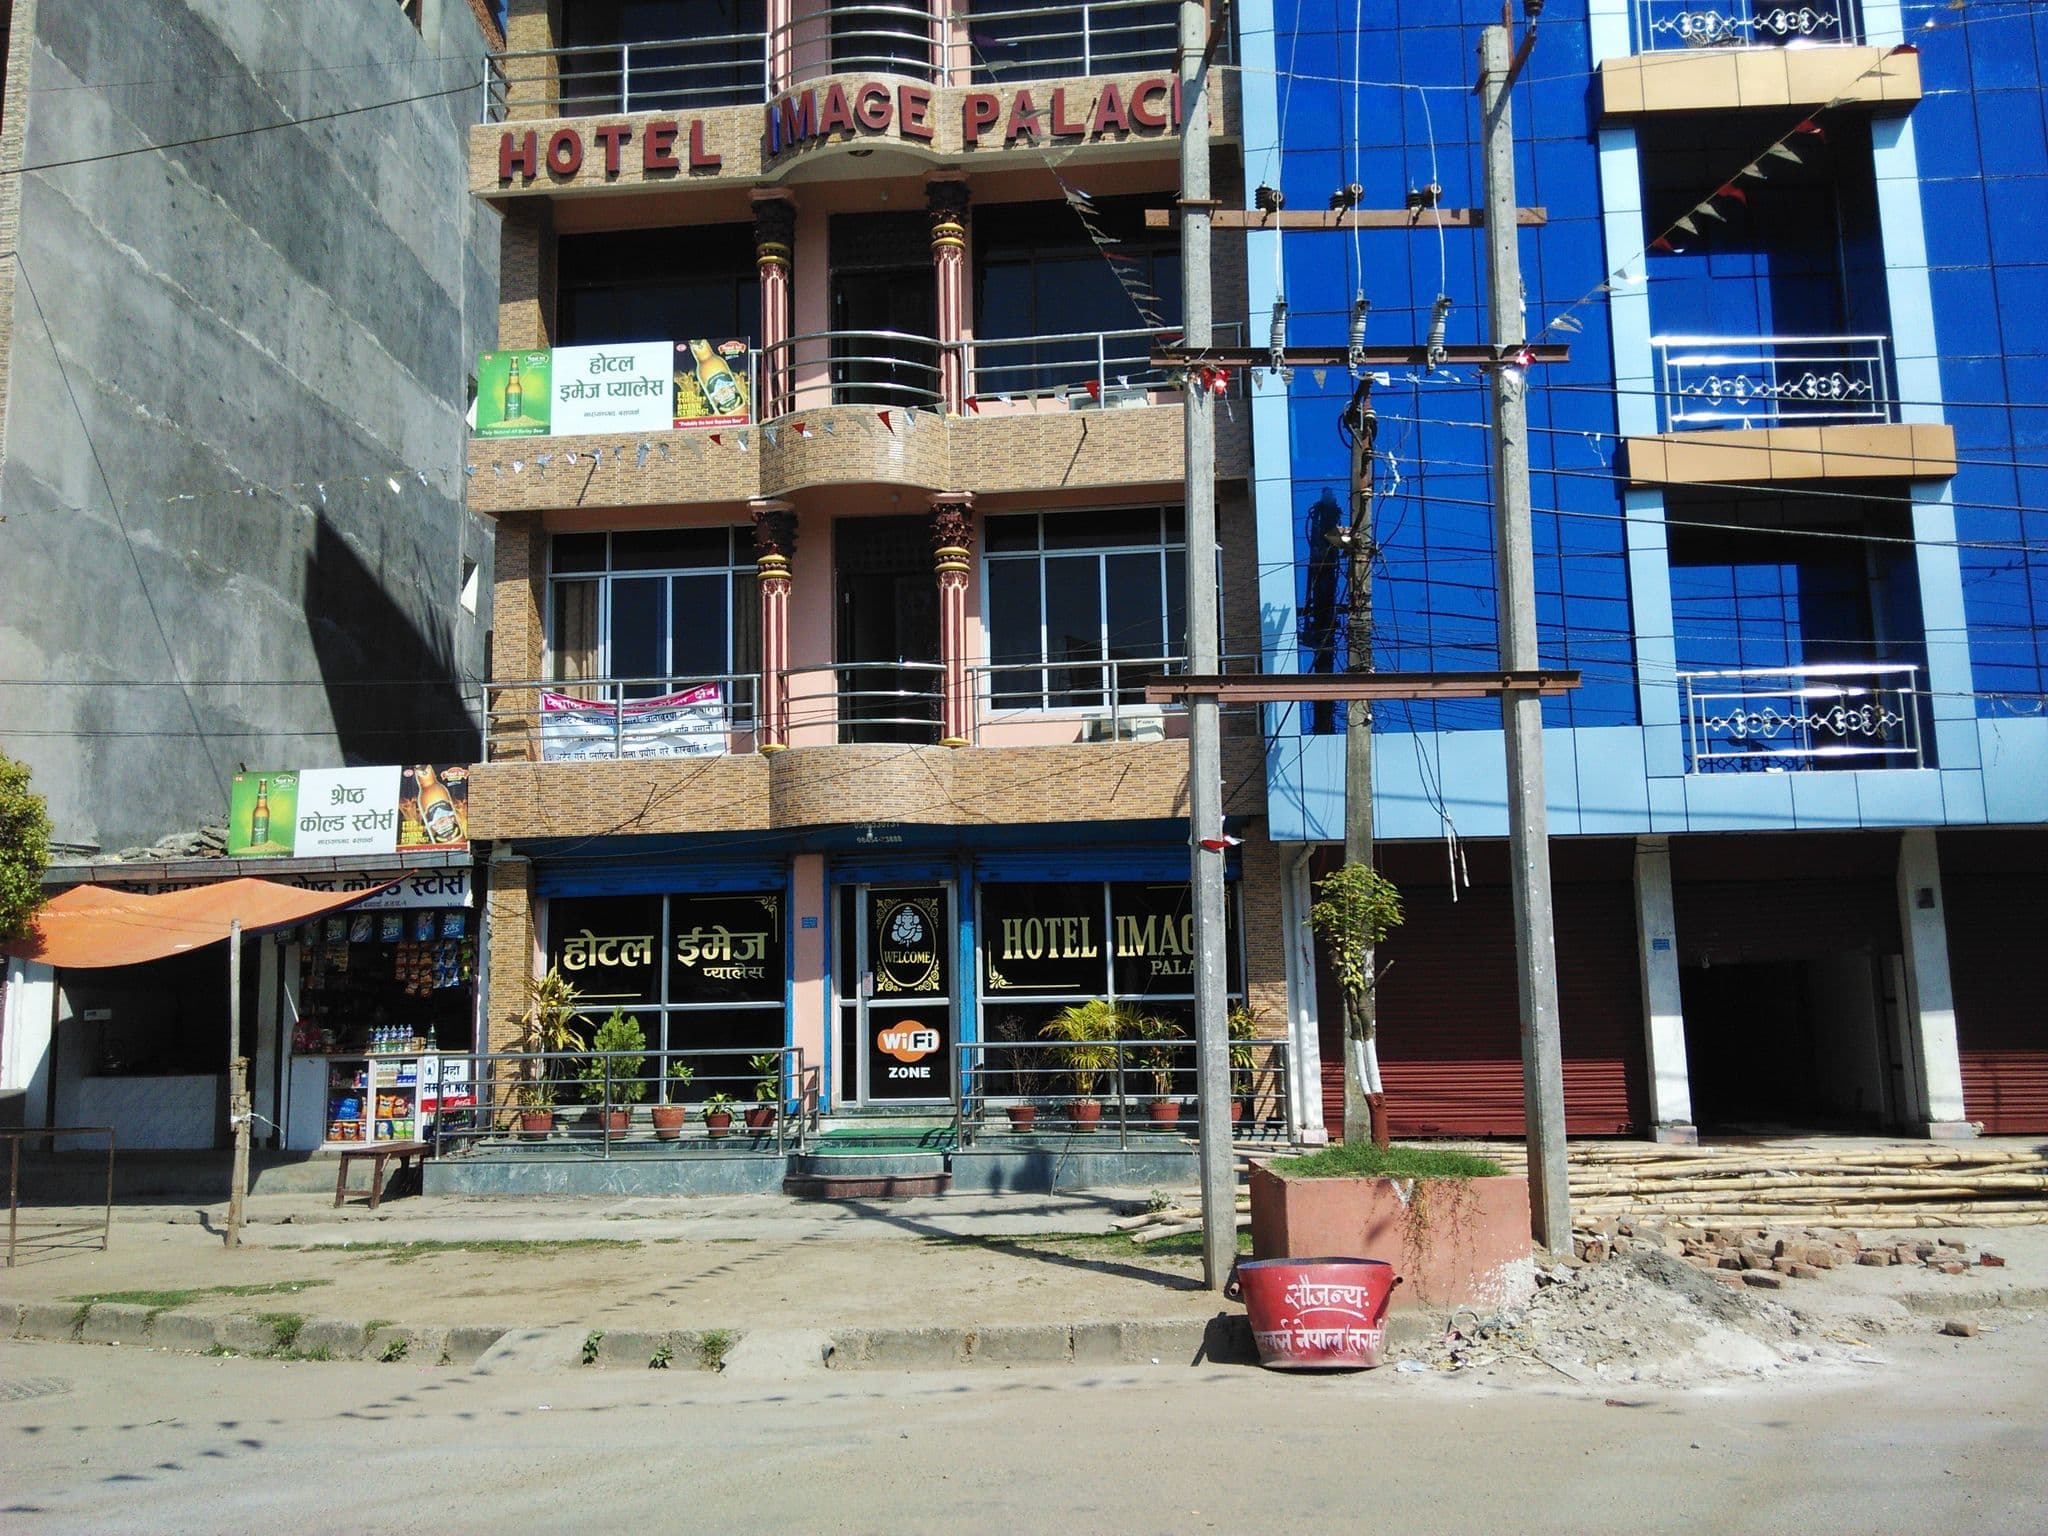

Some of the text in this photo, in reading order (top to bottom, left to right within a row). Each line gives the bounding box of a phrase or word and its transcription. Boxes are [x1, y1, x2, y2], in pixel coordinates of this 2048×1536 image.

[500, 74, 1212, 179] HOTEL IMAGE PALAC
[589, 352, 635, 375] होटल
[560, 376, 664, 402] इमेज प्यालेस
[331, 784, 367, 806] श्रेष्ठ
[300, 808, 394, 833] कोल्ड स्टोर्स
[411, 870, 466, 896] स्टोर्स
[563, 925, 768, 970] होटल ईमेज
[1002, 913, 1193, 960] HOTEL IMAG
[884, 950, 931, 965] WELCOME
[703, 962, 765, 979] प्यालेस
[882, 1032, 933, 1050] WiFi
[888, 1066, 931, 1079] ZONE
